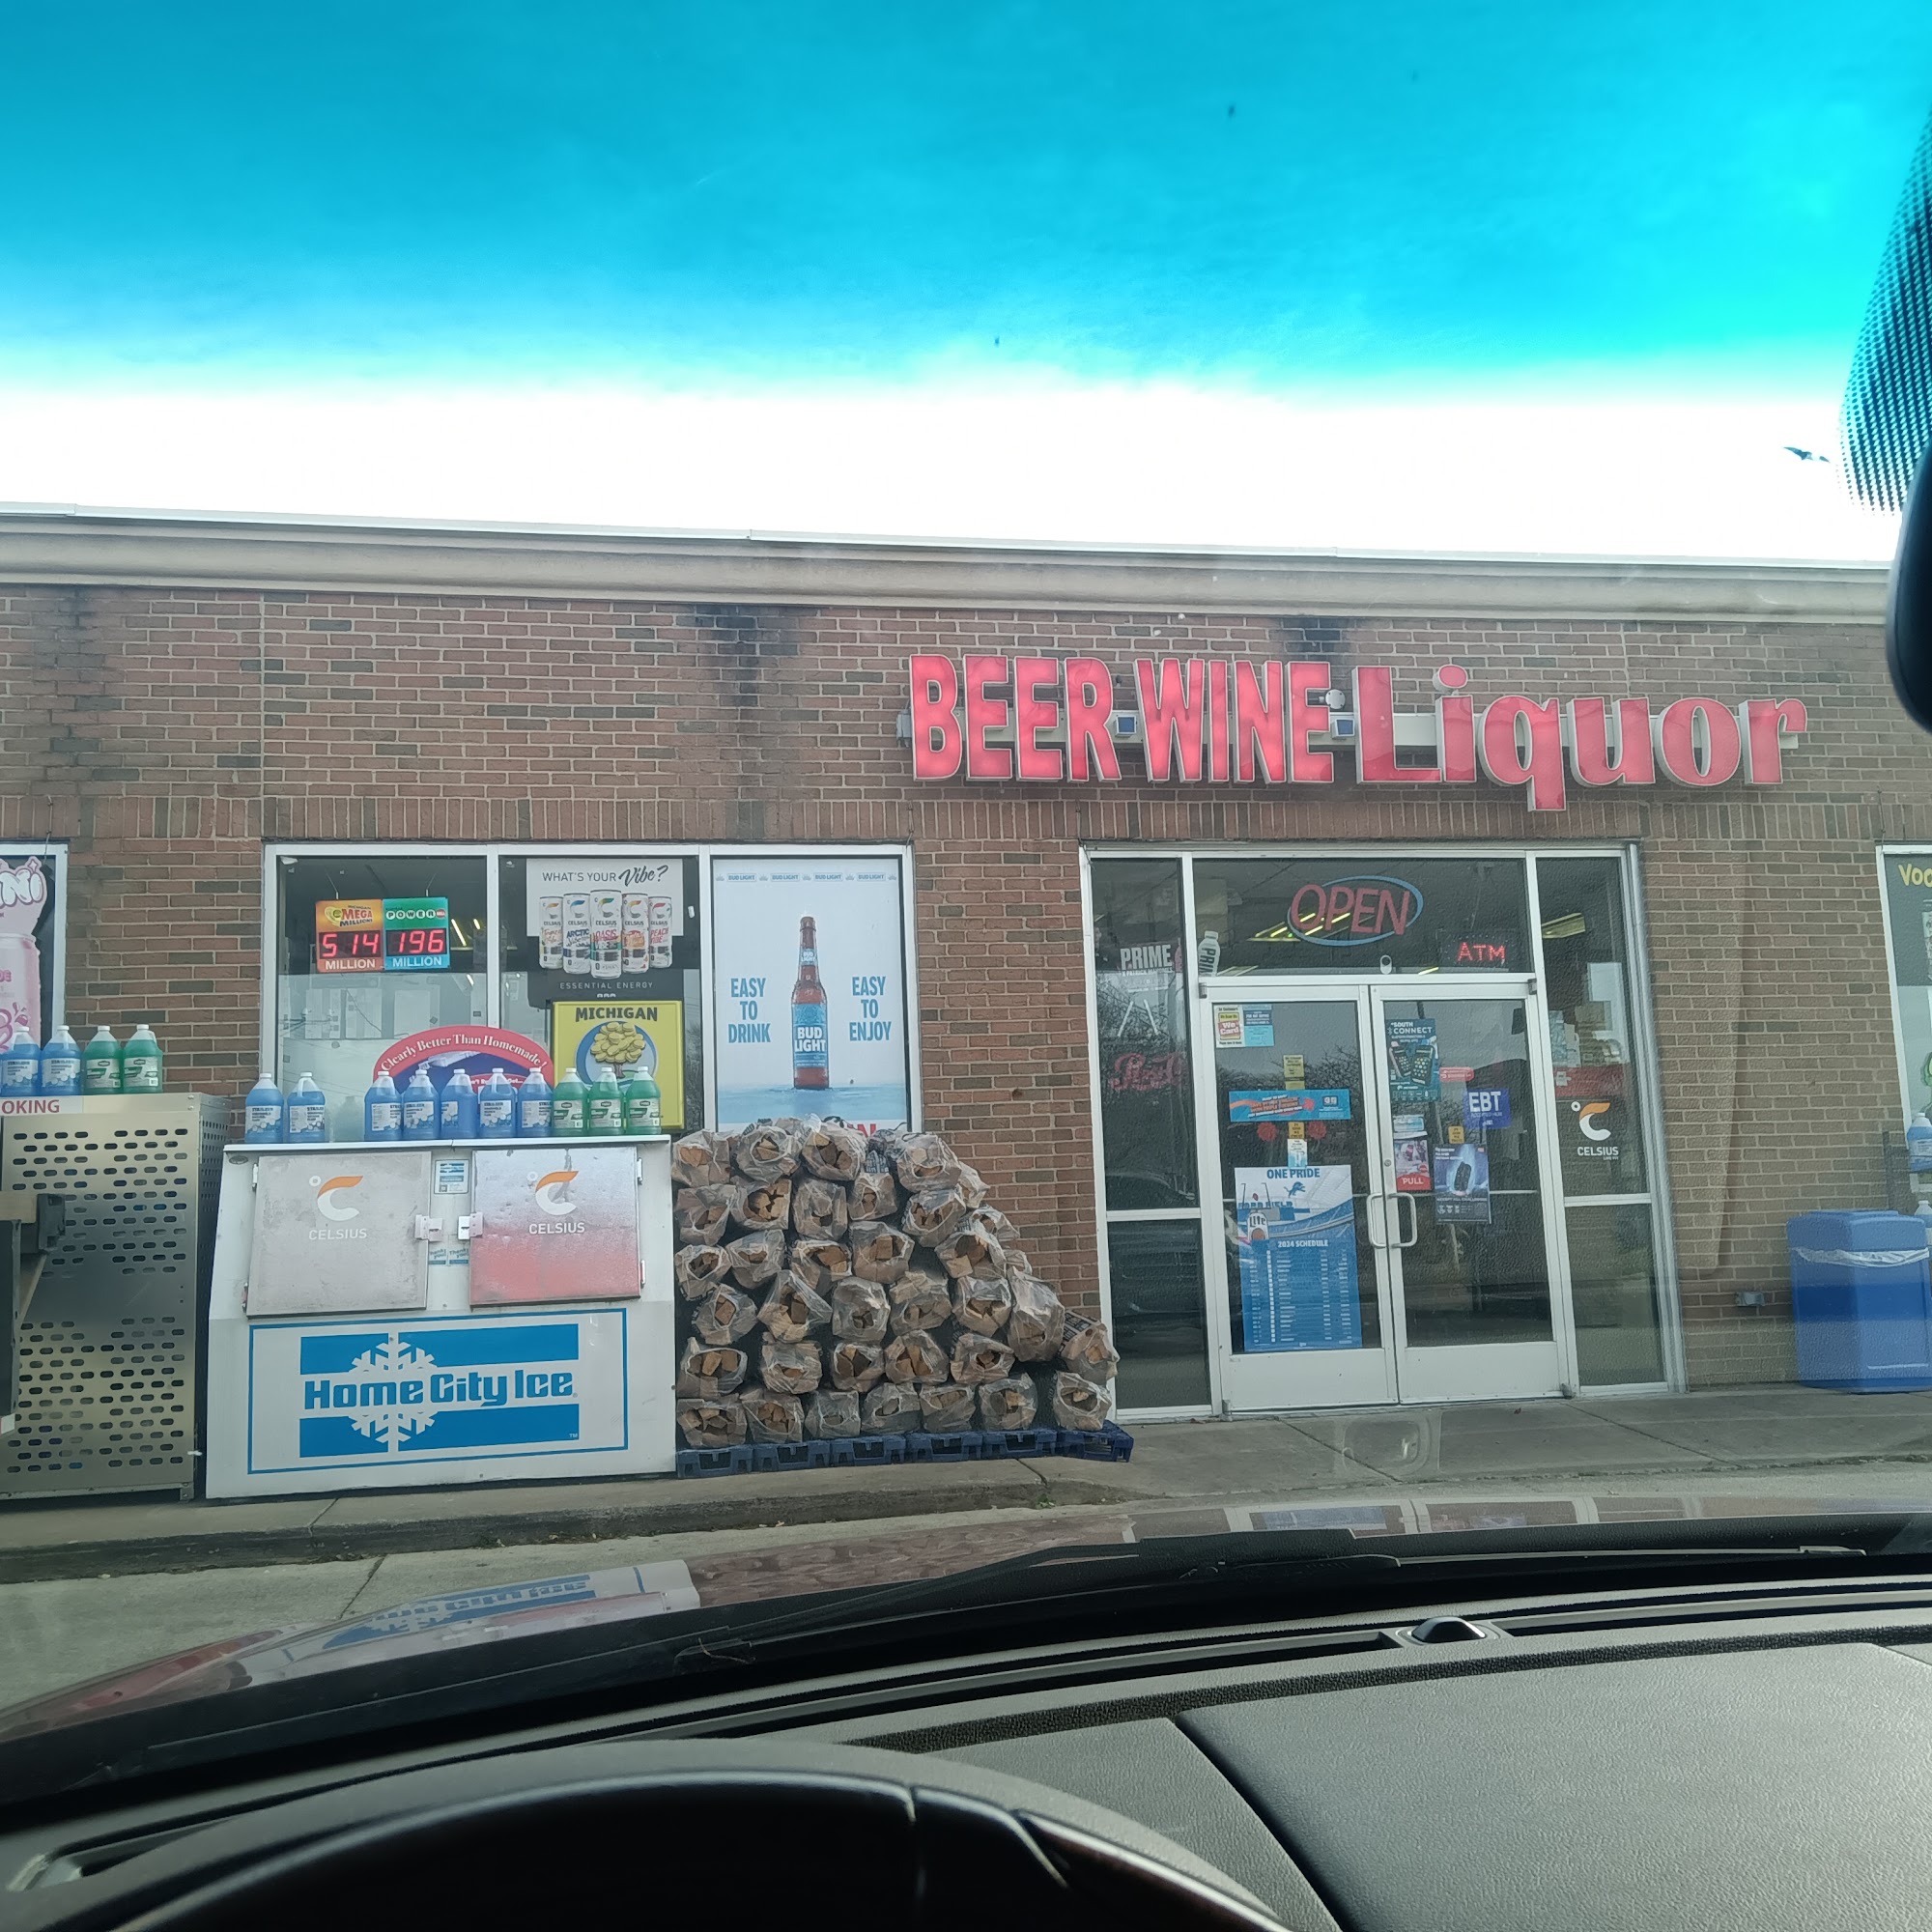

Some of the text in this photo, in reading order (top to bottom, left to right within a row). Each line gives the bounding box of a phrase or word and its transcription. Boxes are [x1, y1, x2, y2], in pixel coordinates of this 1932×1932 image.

[909, 654, 1807, 812] BEER WINE Liquor
[542, 865, 668, 887] WHAT'S YOUR Vibe?
[342, 908, 373, 921] MEGA
[1290, 884, 1410, 935] OPEN
[398, 929, 444, 953] 196
[1121, 944, 1173, 971] PRIME
[1457, 941, 1506, 962] ATM
[326, 958, 376, 970] MILLION
[392, 956, 442, 967] MILLION
[559, 981, 612, 990] ESSENTIAL
[730, 978, 767, 998] EASY
[852, 976, 887, 996] EASY
[575, 1007, 658, 1022] MICHIGAN
[740, 1001, 758, 1020] TO
[861, 999, 879, 1019] TO
[728, 1023, 771, 1043] DRINK
[797, 1027, 823, 1039] BUD
[849, 1021, 892, 1041] ENJOY
[381, 1046, 416, 1071] Clearly
[417, 1037, 451, 1051] Better
[452, 1034, 482, 1044] Than
[794, 1039, 826, 1052] LIGHT
[1, 1099, 60, 1115] OKING
[1468, 1091, 1501, 1112] EBT
[1577, 1146, 1619, 1156] CELSIUS
[1266, 1168, 1321, 1179] ONE PRIDE
[1402, 1177, 1424, 1185] PULL
[309, 1228, 367, 1240] CELSIUS
[528, 1222, 585, 1235] CELSIUS
[304, 1370, 573, 1410] Home City Ice
